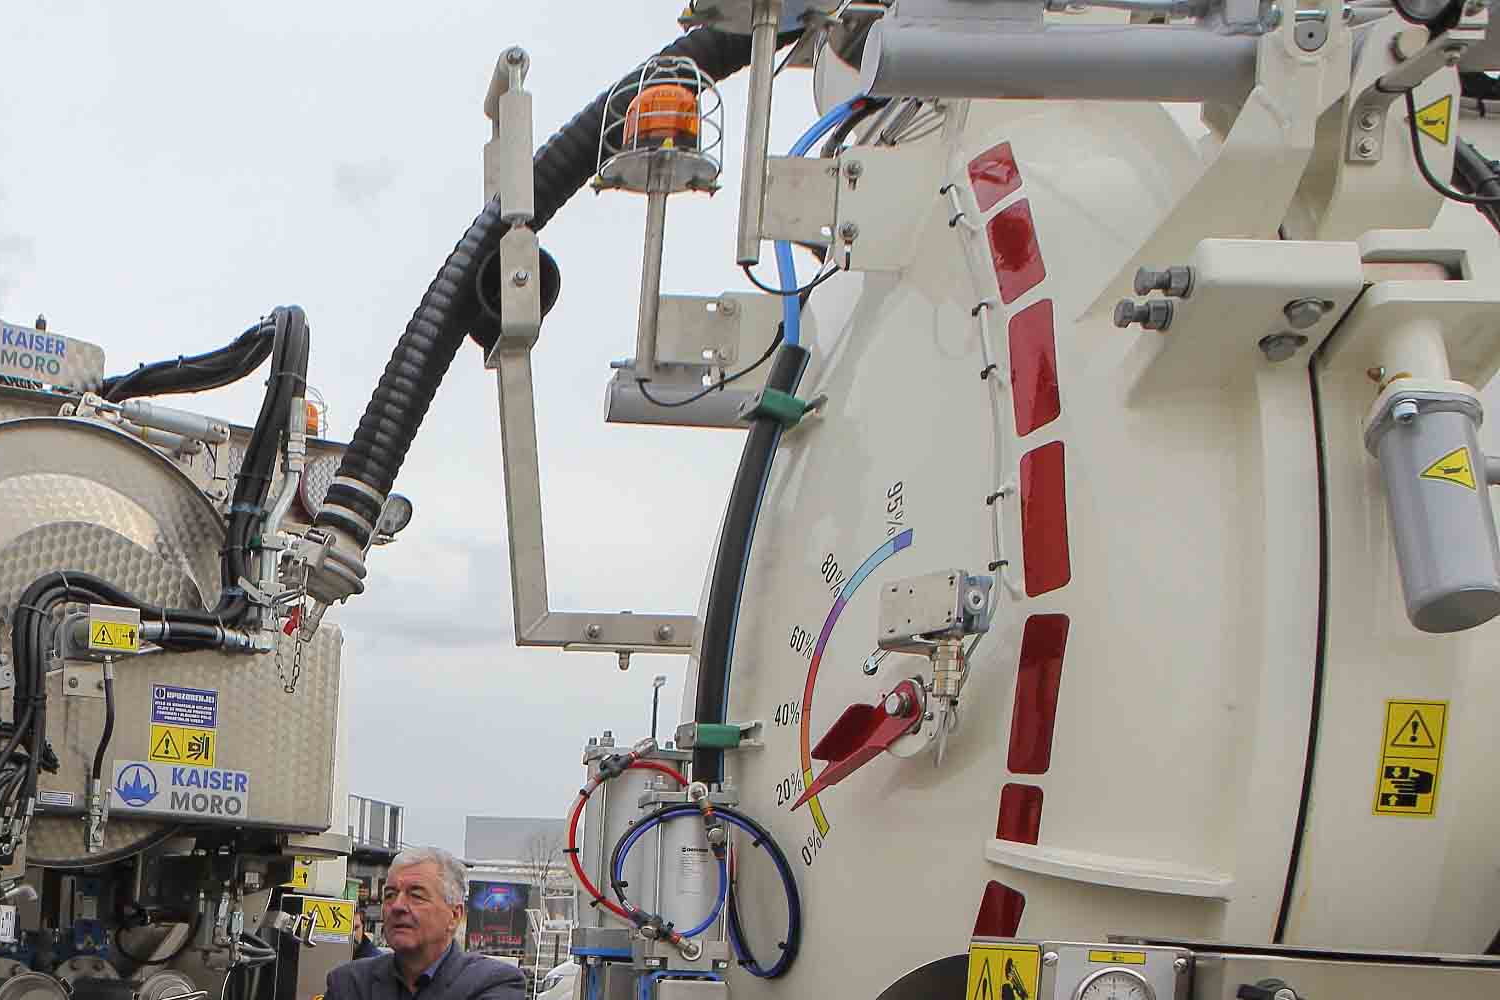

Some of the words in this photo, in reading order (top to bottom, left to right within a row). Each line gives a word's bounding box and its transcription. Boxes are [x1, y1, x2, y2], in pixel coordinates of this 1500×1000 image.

[2, 327, 65, 358] KAISER
[0, 349, 60, 375] MORO
[886, 480, 905, 536] 95%
[820, 552, 845, 599] 80%
[788, 626, 814, 661] 60%
[774, 703, 800, 727] 40%
[171, 767, 248, 793] KAISER
[775, 771, 802, 806] 20%
[170, 791, 242, 816] MORO
[801, 830, 824, 867] 0%
